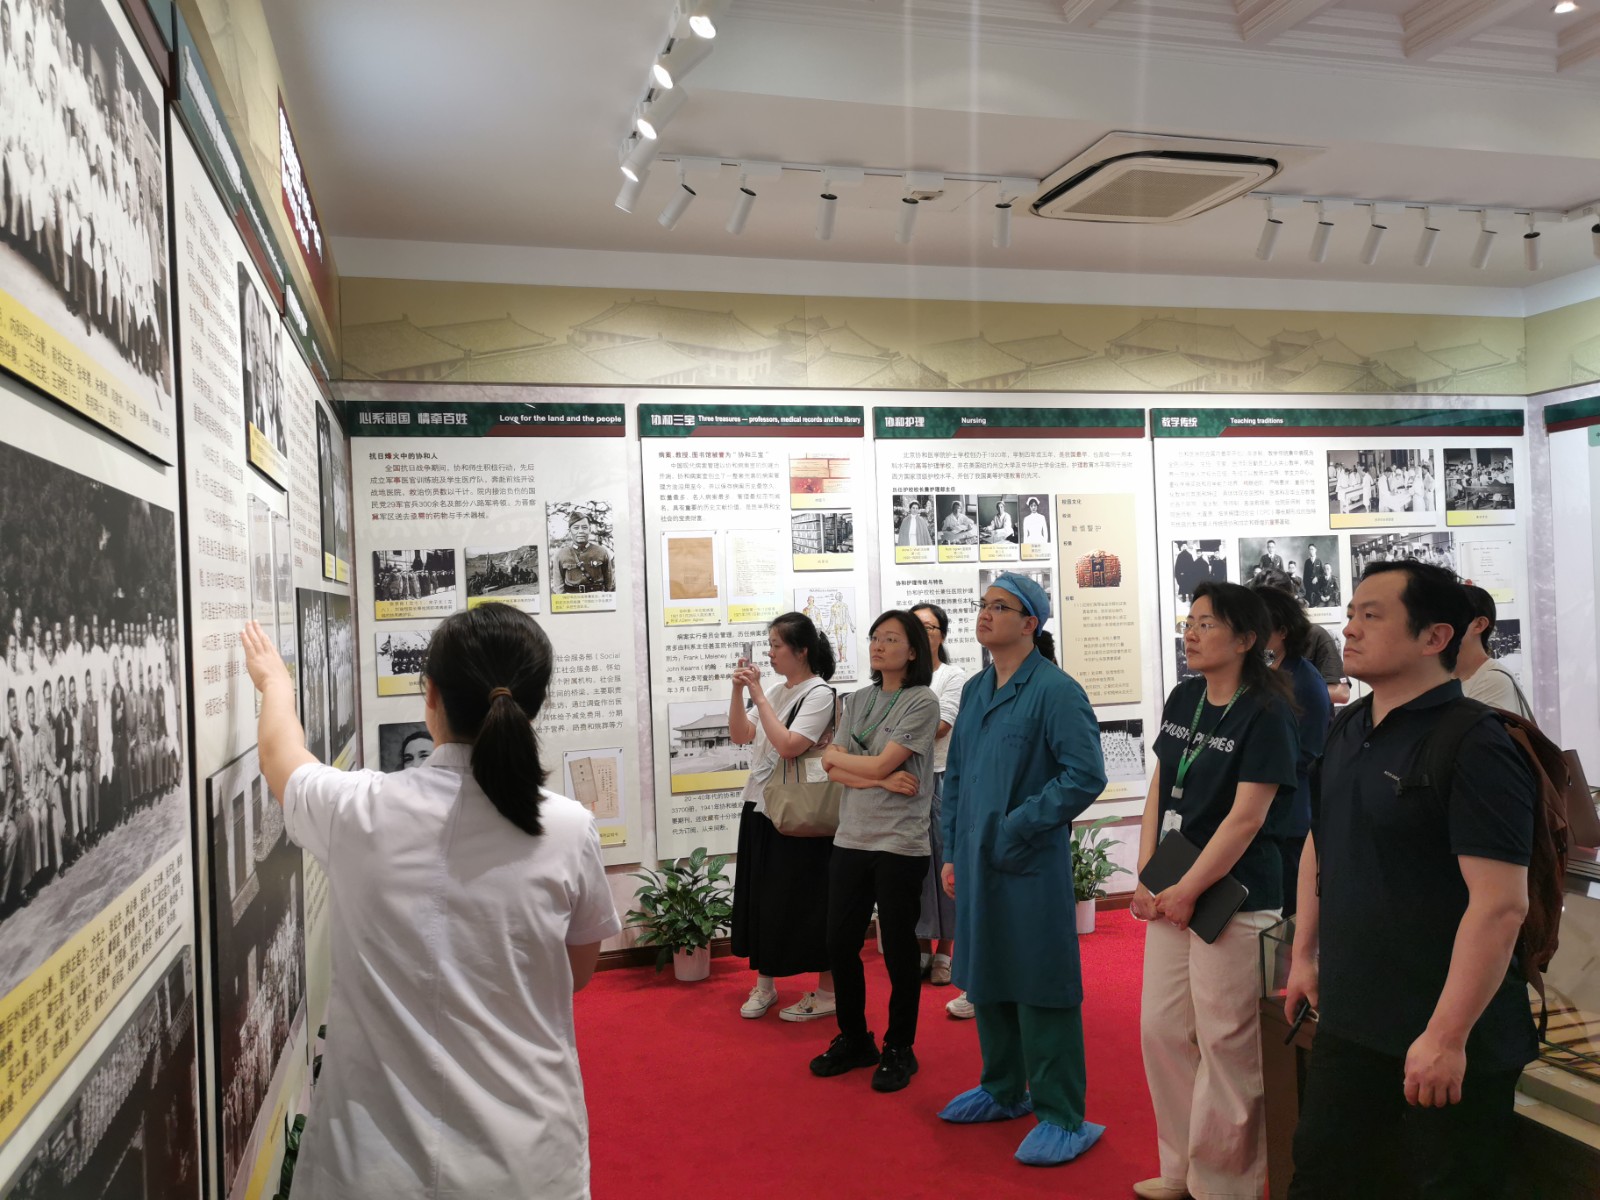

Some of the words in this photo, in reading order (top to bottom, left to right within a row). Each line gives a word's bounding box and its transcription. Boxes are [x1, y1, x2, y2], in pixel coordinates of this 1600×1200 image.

[359, 412, 411, 425] 心系祖国
[417, 412, 468, 425] 情牵百姓
[499, 414, 519, 422] Love
[520, 414, 532, 422] for
[533, 414, 546, 422] the
[547, 414, 565, 422] land
[566, 414, 580, 422] and
[596, 415, 622, 424] people
[650, 414, 695, 426] 协和三宝
[697, 414, 715, 422] Three
[715, 415, 741, 423] treasures
[748, 415, 780, 424] professors,
[780, 415, 802, 423] medical
[802, 415, 823, 423] records
[823, 415, 833, 423] and
[834, 415, 843, 423] the
[843, 415, 861, 424] library
[884, 416, 925, 428] 协和护理
[961, 416, 987, 425] Nursing
[1161, 416, 1198, 428] 教学传统
[1230, 417, 1256, 425] Teaching
[368, 452, 438, 461] 抗日烽火中的协和人
[600, 652, 621, 660] Social
[683, 653, 699, 661] Frank
[666, 665, 680, 673] John
[1160, 719, 1191, 742] HUSH
[1192, 731, 1236, 753] PPIES
